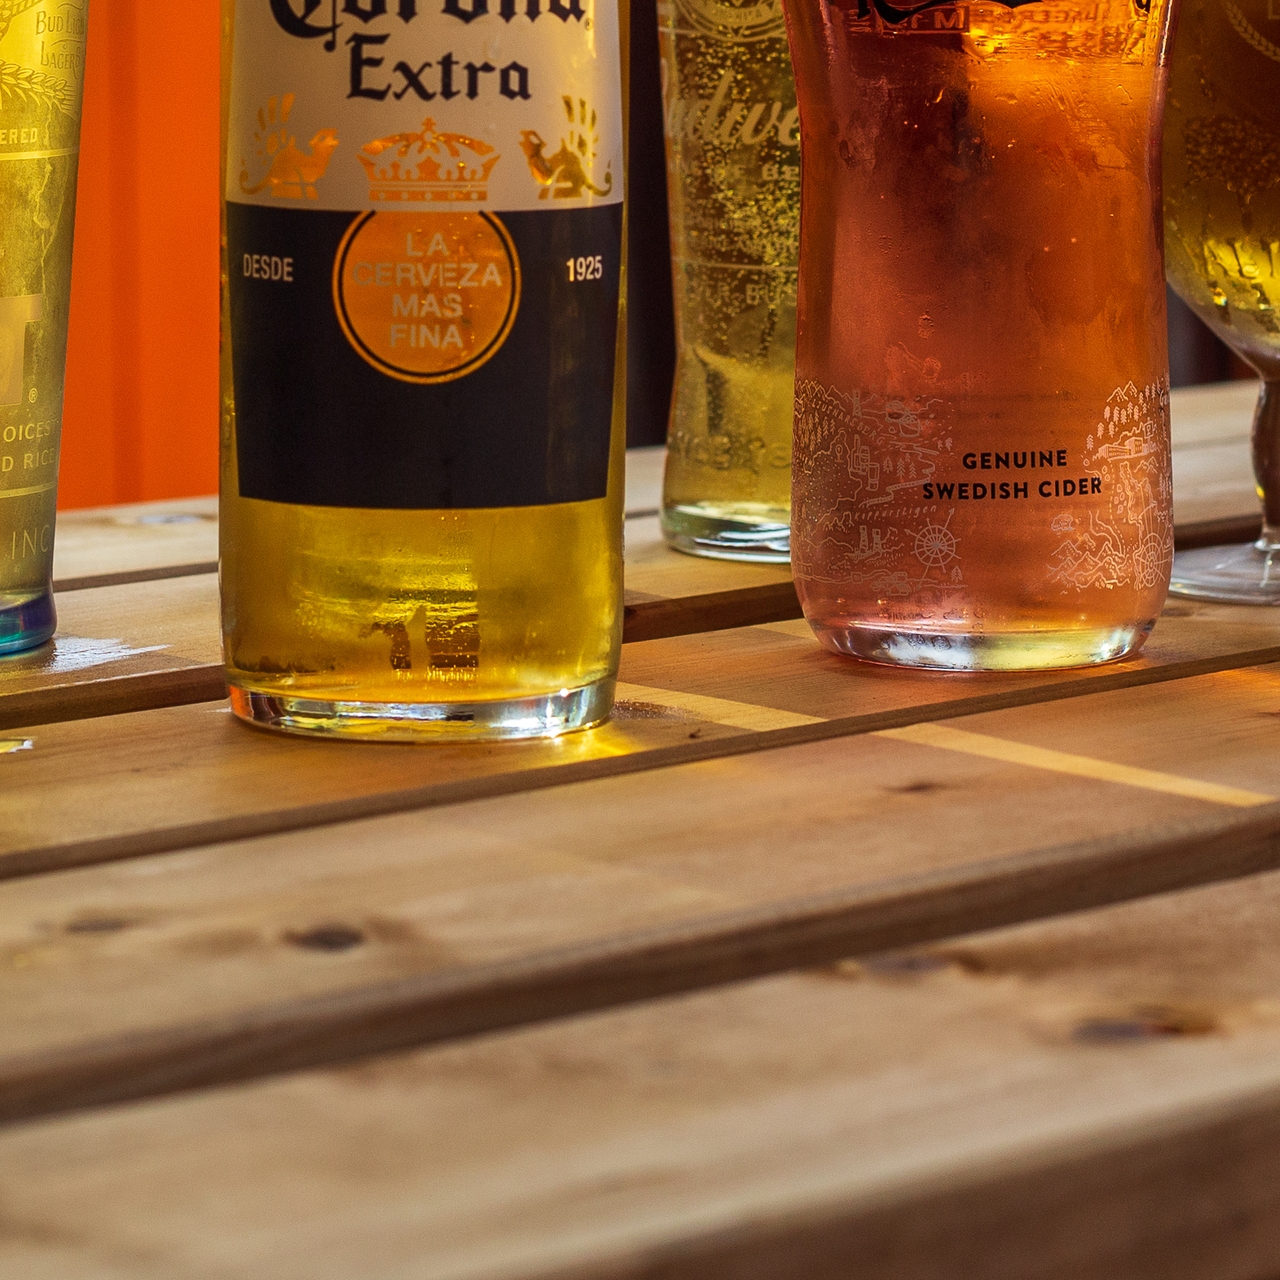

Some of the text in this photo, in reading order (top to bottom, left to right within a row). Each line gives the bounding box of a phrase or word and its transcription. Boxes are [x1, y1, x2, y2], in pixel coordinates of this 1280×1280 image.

[345, 32, 533, 102] Extra
[405, 231, 450, 257] LA
[242, 252, 295, 283] DESDE
[351, 259, 504, 288] CERVEZA
[565, 254, 604, 284] 1925
[391, 291, 464, 319] MAS
[388, 322, 465, 350] FINA
[22, 447, 56, 470] RICE
[961, 449, 1068, 470] GENUINE
[922, 477, 1104, 501] SWEDISH CIDER
